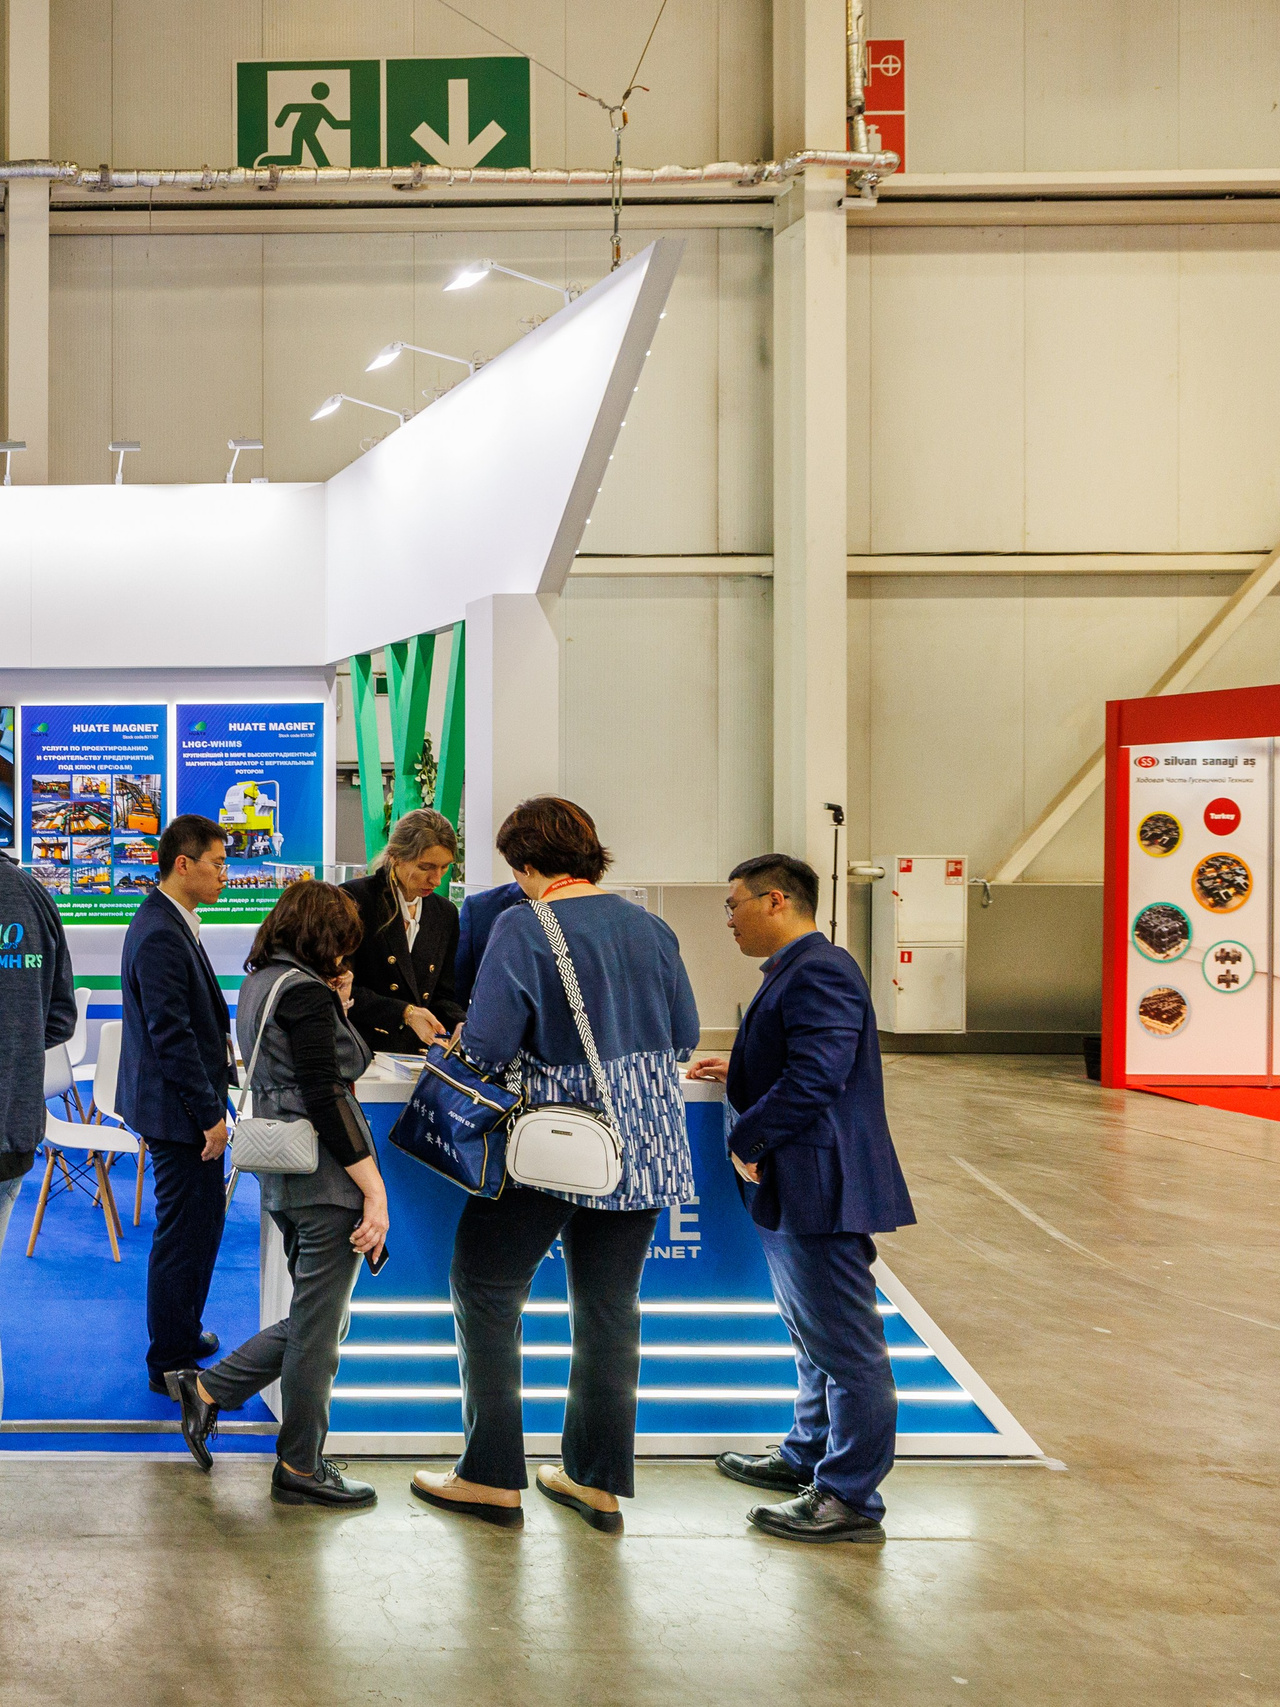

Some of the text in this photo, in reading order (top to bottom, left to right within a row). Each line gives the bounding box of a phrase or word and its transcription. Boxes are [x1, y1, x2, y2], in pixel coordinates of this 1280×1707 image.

[72, 723, 159, 733] HUATE MAGNET
[228, 721, 316, 732] HUATE MAGNET
[182, 740, 243, 748] LHGC-WHIMS
[1164, 756, 1197, 766] silvan
[1202, 756, 1238, 768] sanayi
[1243, 757, 1256, 768] aş
[645, 1246, 702, 1259] GNET
